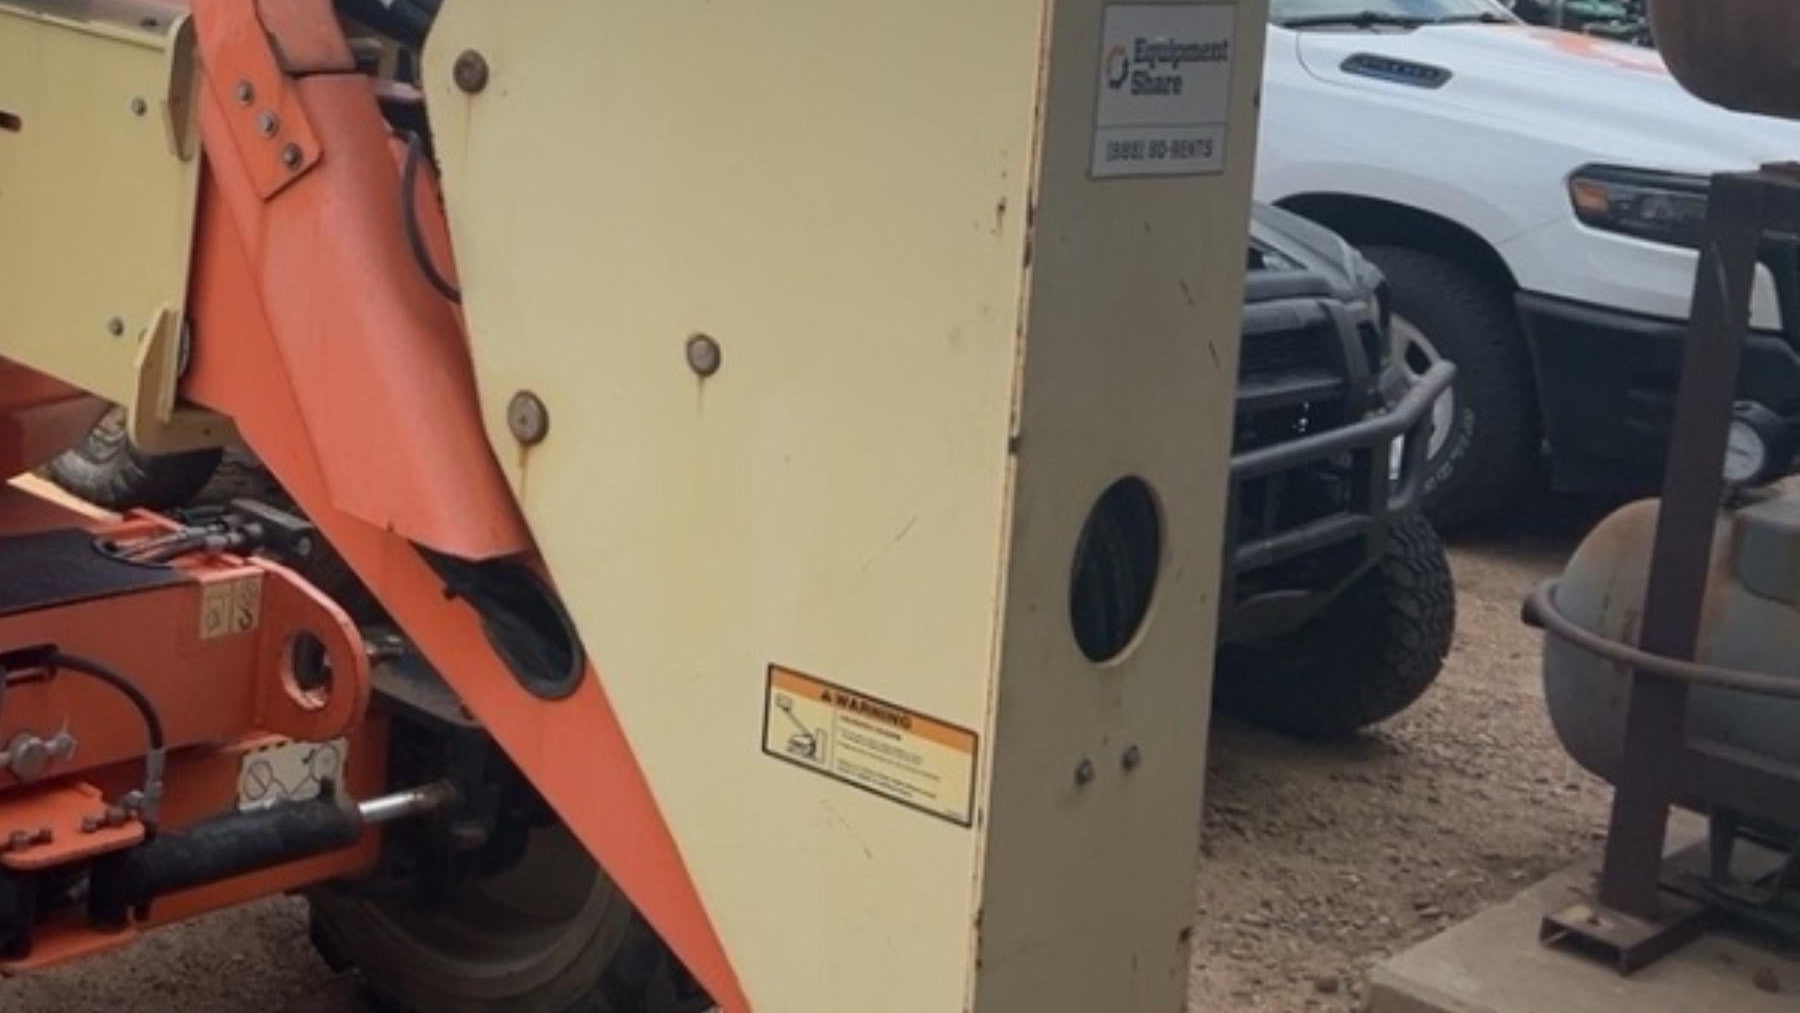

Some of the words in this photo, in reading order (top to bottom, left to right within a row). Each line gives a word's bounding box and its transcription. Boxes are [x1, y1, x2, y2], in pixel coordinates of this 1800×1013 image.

[1133, 38, 1229, 70] Equipment
[1130, 71, 1183, 96] Share
[834, 690, 913, 730] WARNING
